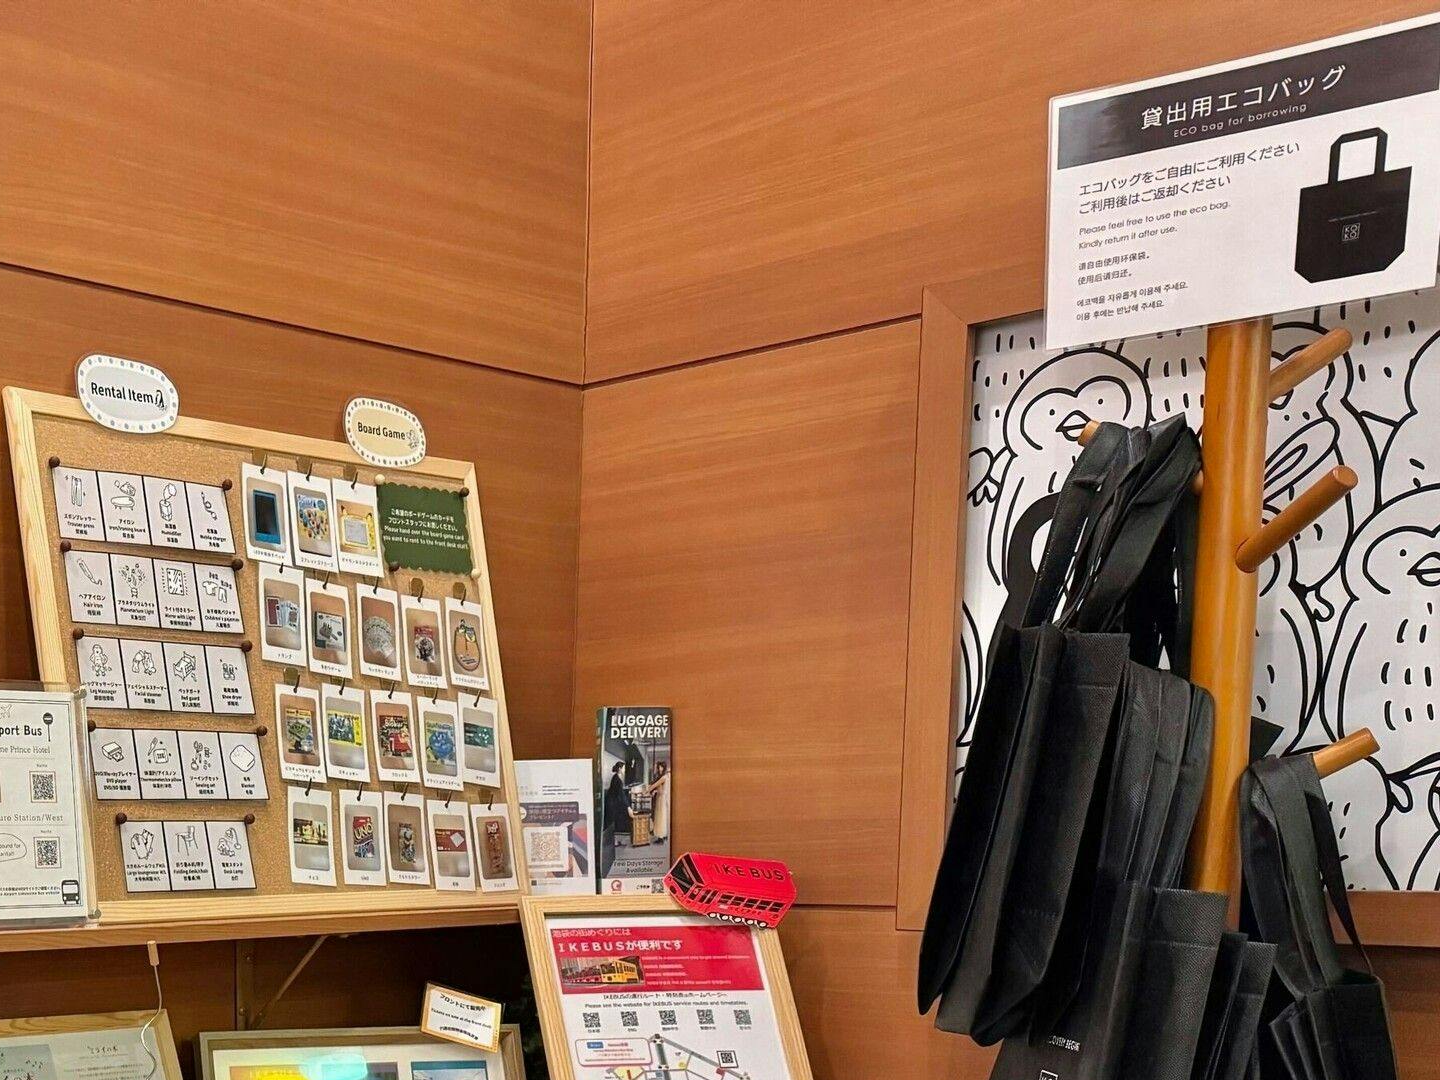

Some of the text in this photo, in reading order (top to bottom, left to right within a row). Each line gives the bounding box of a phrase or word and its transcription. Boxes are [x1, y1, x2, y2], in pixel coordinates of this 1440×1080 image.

[1141, 65, 1347, 131] 貸出用エコバッグ
[1173, 103, 1307, 138] ECO bag for borrowing
[1079, 141, 1301, 196] エコバッグをご自由にご利用ください
[1079, 174, 1232, 215] ご利用後はご返却ください
[1079, 225, 1106, 236] Please
[1108, 220, 1124, 229] feel
[1126, 218, 1143, 226] free
[1156, 213, 1170, 221] use
[1173, 209, 1187, 217] the
[1189, 206, 1207, 214] eco
[1210, 201, 1231, 211] bag.
[1078, 239, 1103, 250] Kindly
[1104, 234, 1129, 245] return
[1138, 229, 1158, 238] after
[1161, 226, 1177, 234] use.
[91, 382, 153, 403] Rental Item
[357, 422, 405, 439] Board Game
[24, 726, 42, 736] Bus
[611, 714, 669, 727] LUGGAGE
[611, 726, 668, 739] DELIVERY
[354, 824, 373, 839] UNO
[714, 863, 785, 881] IKE BUS
